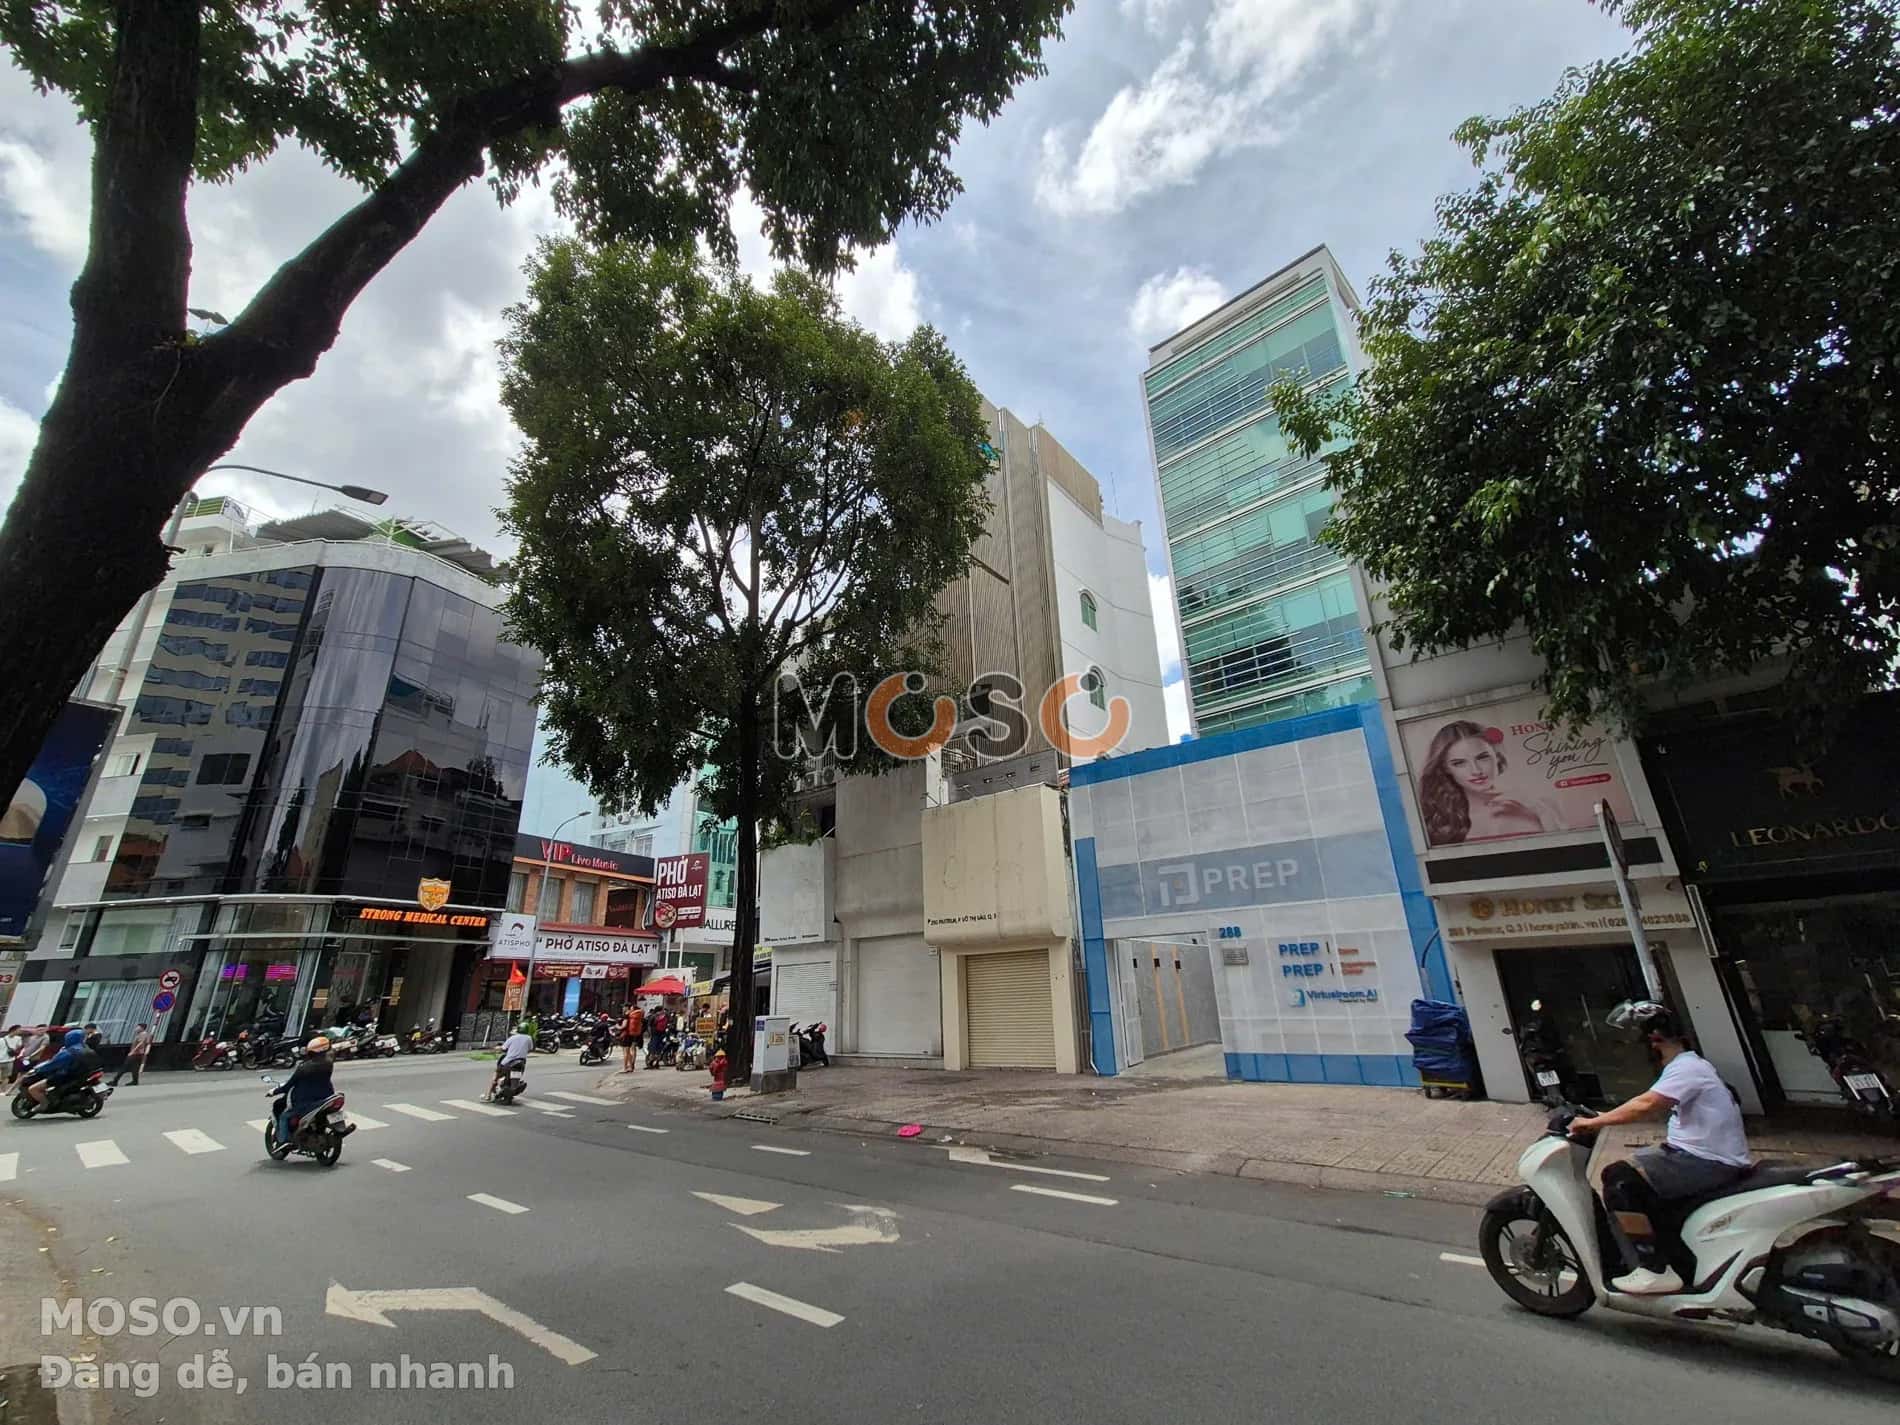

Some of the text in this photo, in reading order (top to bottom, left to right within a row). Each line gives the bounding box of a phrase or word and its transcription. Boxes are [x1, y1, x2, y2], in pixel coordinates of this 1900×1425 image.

[1522, 732, 1607, 765] Shining
[1545, 753, 1581, 779] you
[541, 839, 572, 862] VIP
[657, 855, 689, 886] PHỞ
[1201, 858, 1298, 895] PREP
[656, 884, 703, 900] ATISO ĐÀ LẠT
[360, 908, 487, 927] STRONG MEDICAL CENTER
[1218, 926, 1242, 939] 288
[545, 935, 574, 950] PHỞ
[576, 940, 610, 953] ATISO
[612, 939, 629, 953] ĐÀ
[631, 944, 651, 957] LẠT
[1278, 942, 1320, 956] PREP
[1282, 963, 1324, 977] PREP
